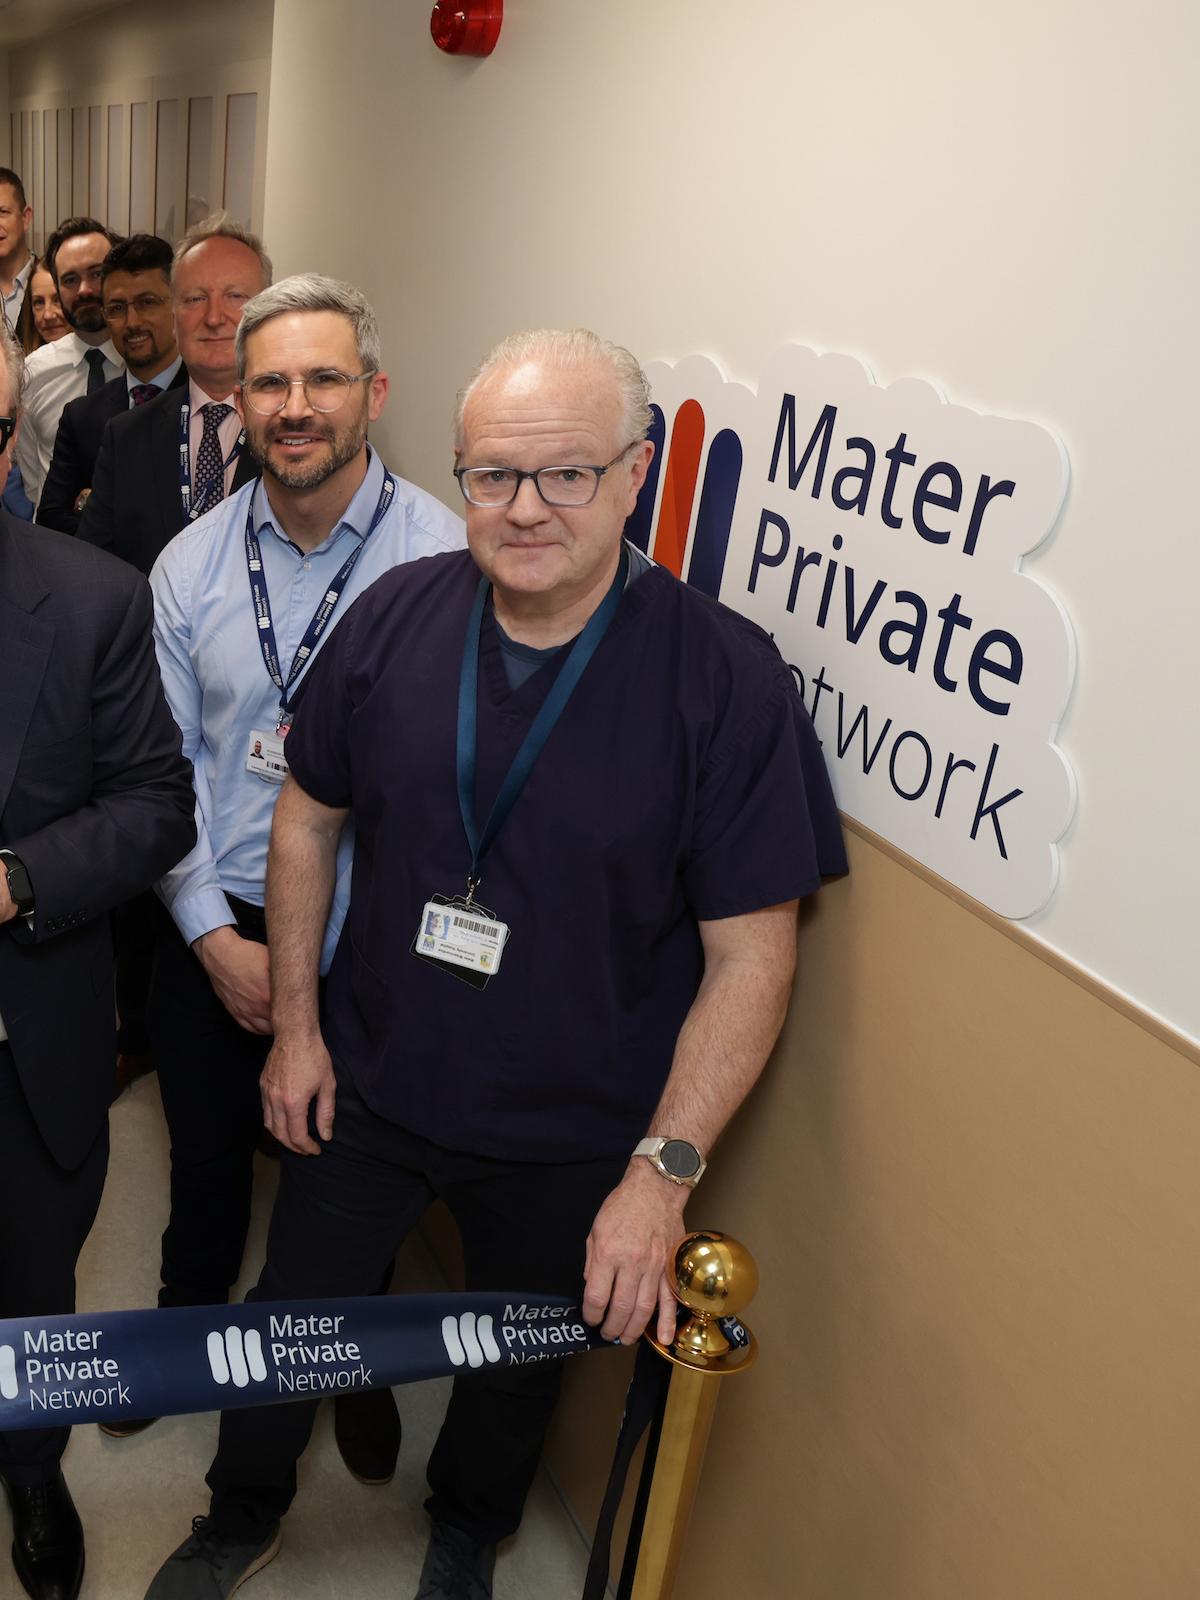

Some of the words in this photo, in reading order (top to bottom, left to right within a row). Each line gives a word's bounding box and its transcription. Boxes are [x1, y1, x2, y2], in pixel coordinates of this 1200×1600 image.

[768, 393, 1016, 556] Mater
[747, 508, 1023, 716] Private
[770, 633, 1024, 860] twork
[269, 1314, 345, 1339] Mater
[502, 1304, 577, 1322] Mater
[23, 1329, 103, 1354] Mater
[501, 1322, 587, 1348] Private
[271, 1340, 361, 1366] Private
[25, 1356, 119, 1384] Private
[277, 1363, 372, 1393] Network
[29, 1380, 132, 1411] Network
